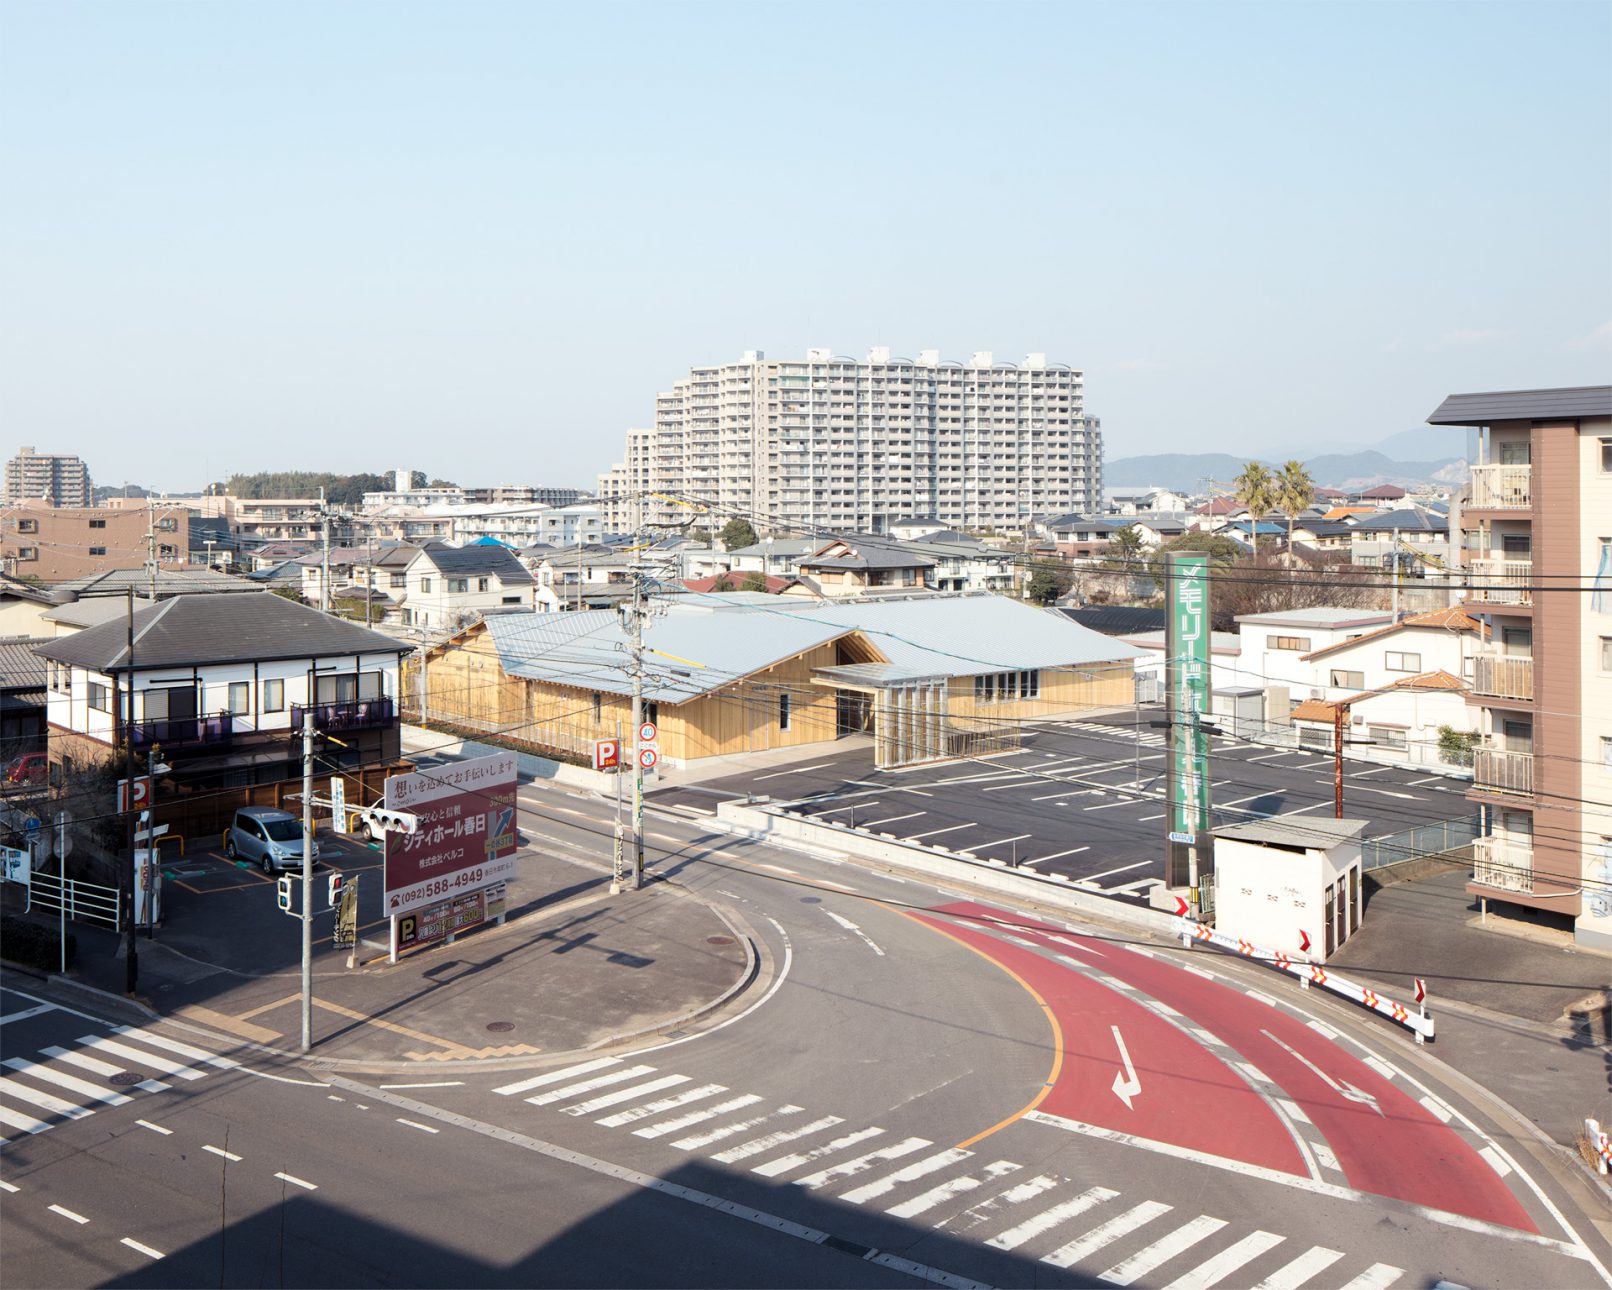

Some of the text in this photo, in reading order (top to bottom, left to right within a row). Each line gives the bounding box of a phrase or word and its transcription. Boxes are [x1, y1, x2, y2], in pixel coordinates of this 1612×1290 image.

[643, 728, 653, 737] 40
[599, 743, 615, 765] P
[394, 760, 514, 798] 想いを込めてお手伝いします
[404, 813, 486, 852] シティホール春日
[419, 847, 464, 869] 株式会社ベルコ
[402, 919, 414, 942] P
